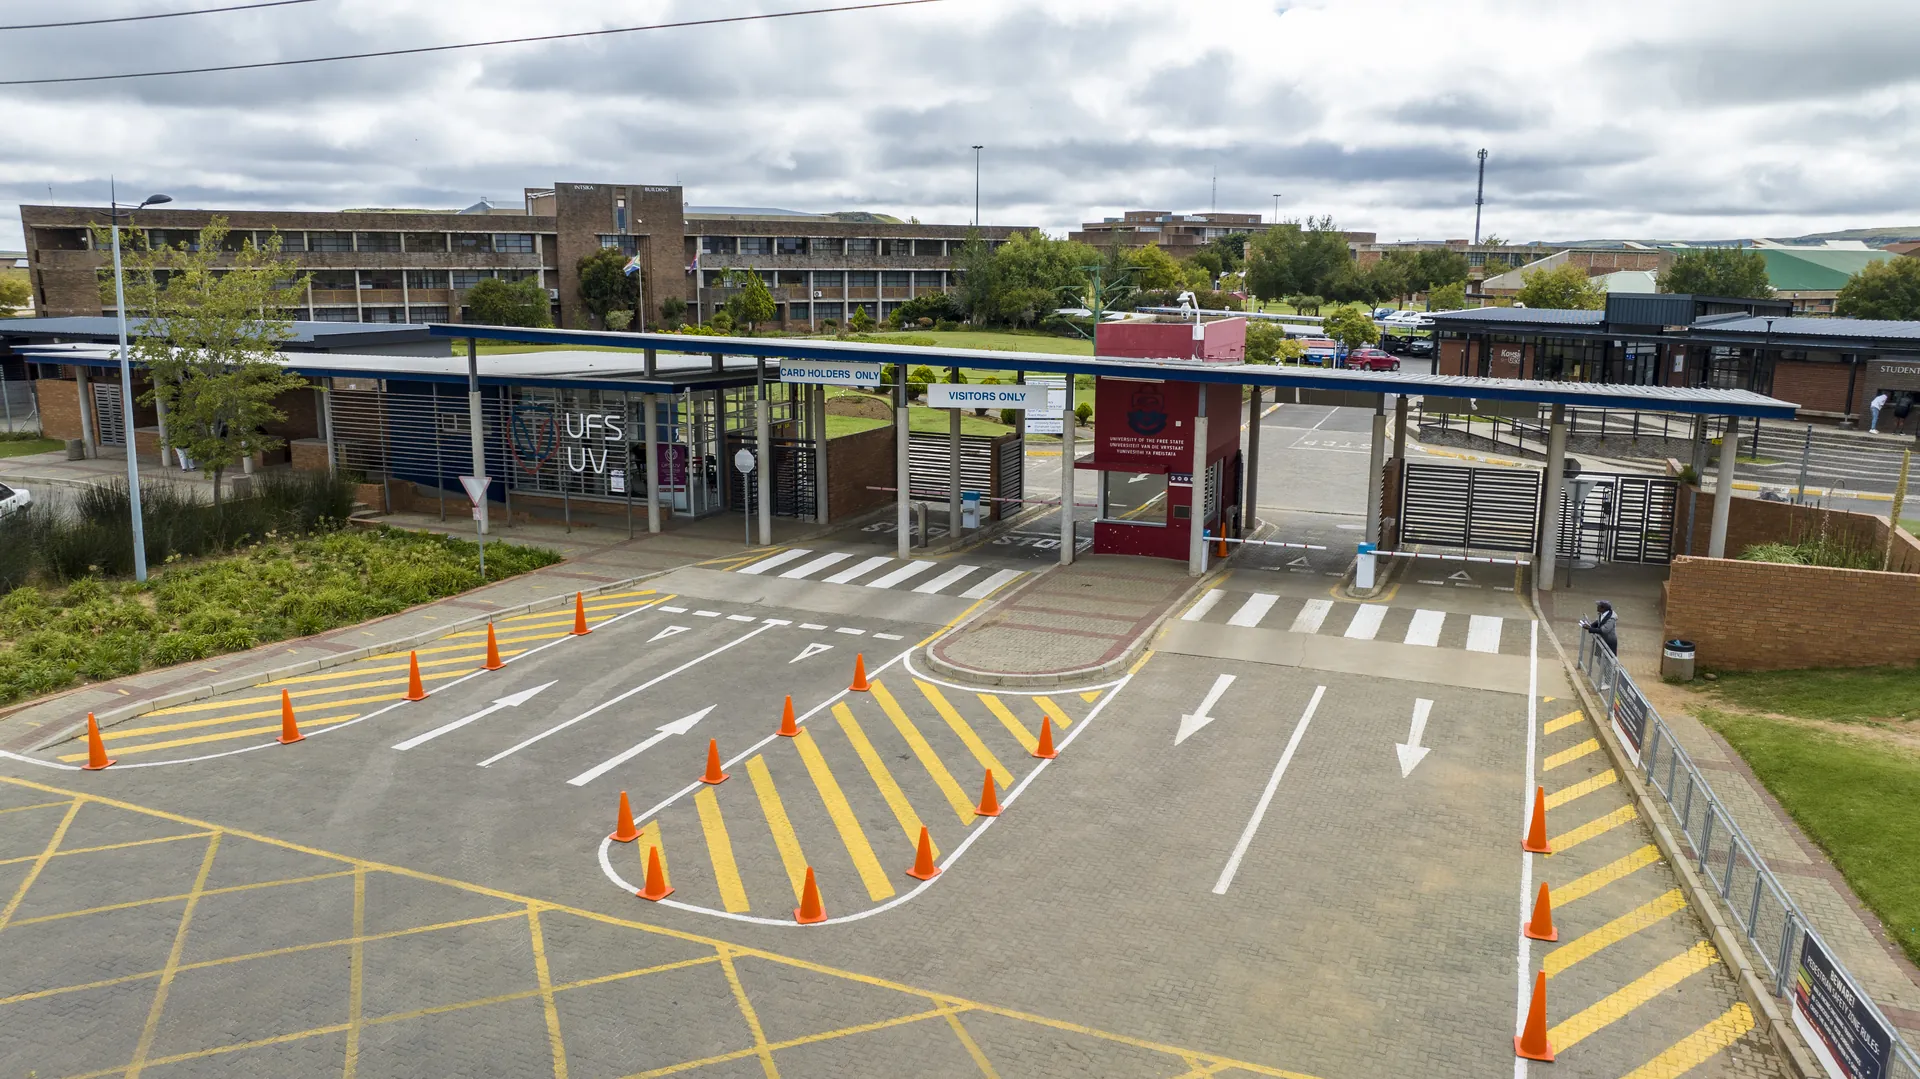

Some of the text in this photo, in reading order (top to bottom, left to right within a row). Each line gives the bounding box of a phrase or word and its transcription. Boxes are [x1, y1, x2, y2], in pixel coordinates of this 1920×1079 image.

[780, 368, 880, 380] CARD HOLDERS ONLY
[948, 392, 1027, 402] VISITORS ONLY
[566, 412, 622, 440] UFS
[568, 446, 608, 474] UV
[1830, 970, 1856, 1008] BEWARE!
[1807, 956, 1832, 993] PEDESTRIAN
[1832, 988, 1849, 1014] SAFETY
[1847, 1010, 1860, 1032] ZONE
[1860, 1026, 1880, 1056] RULES:
